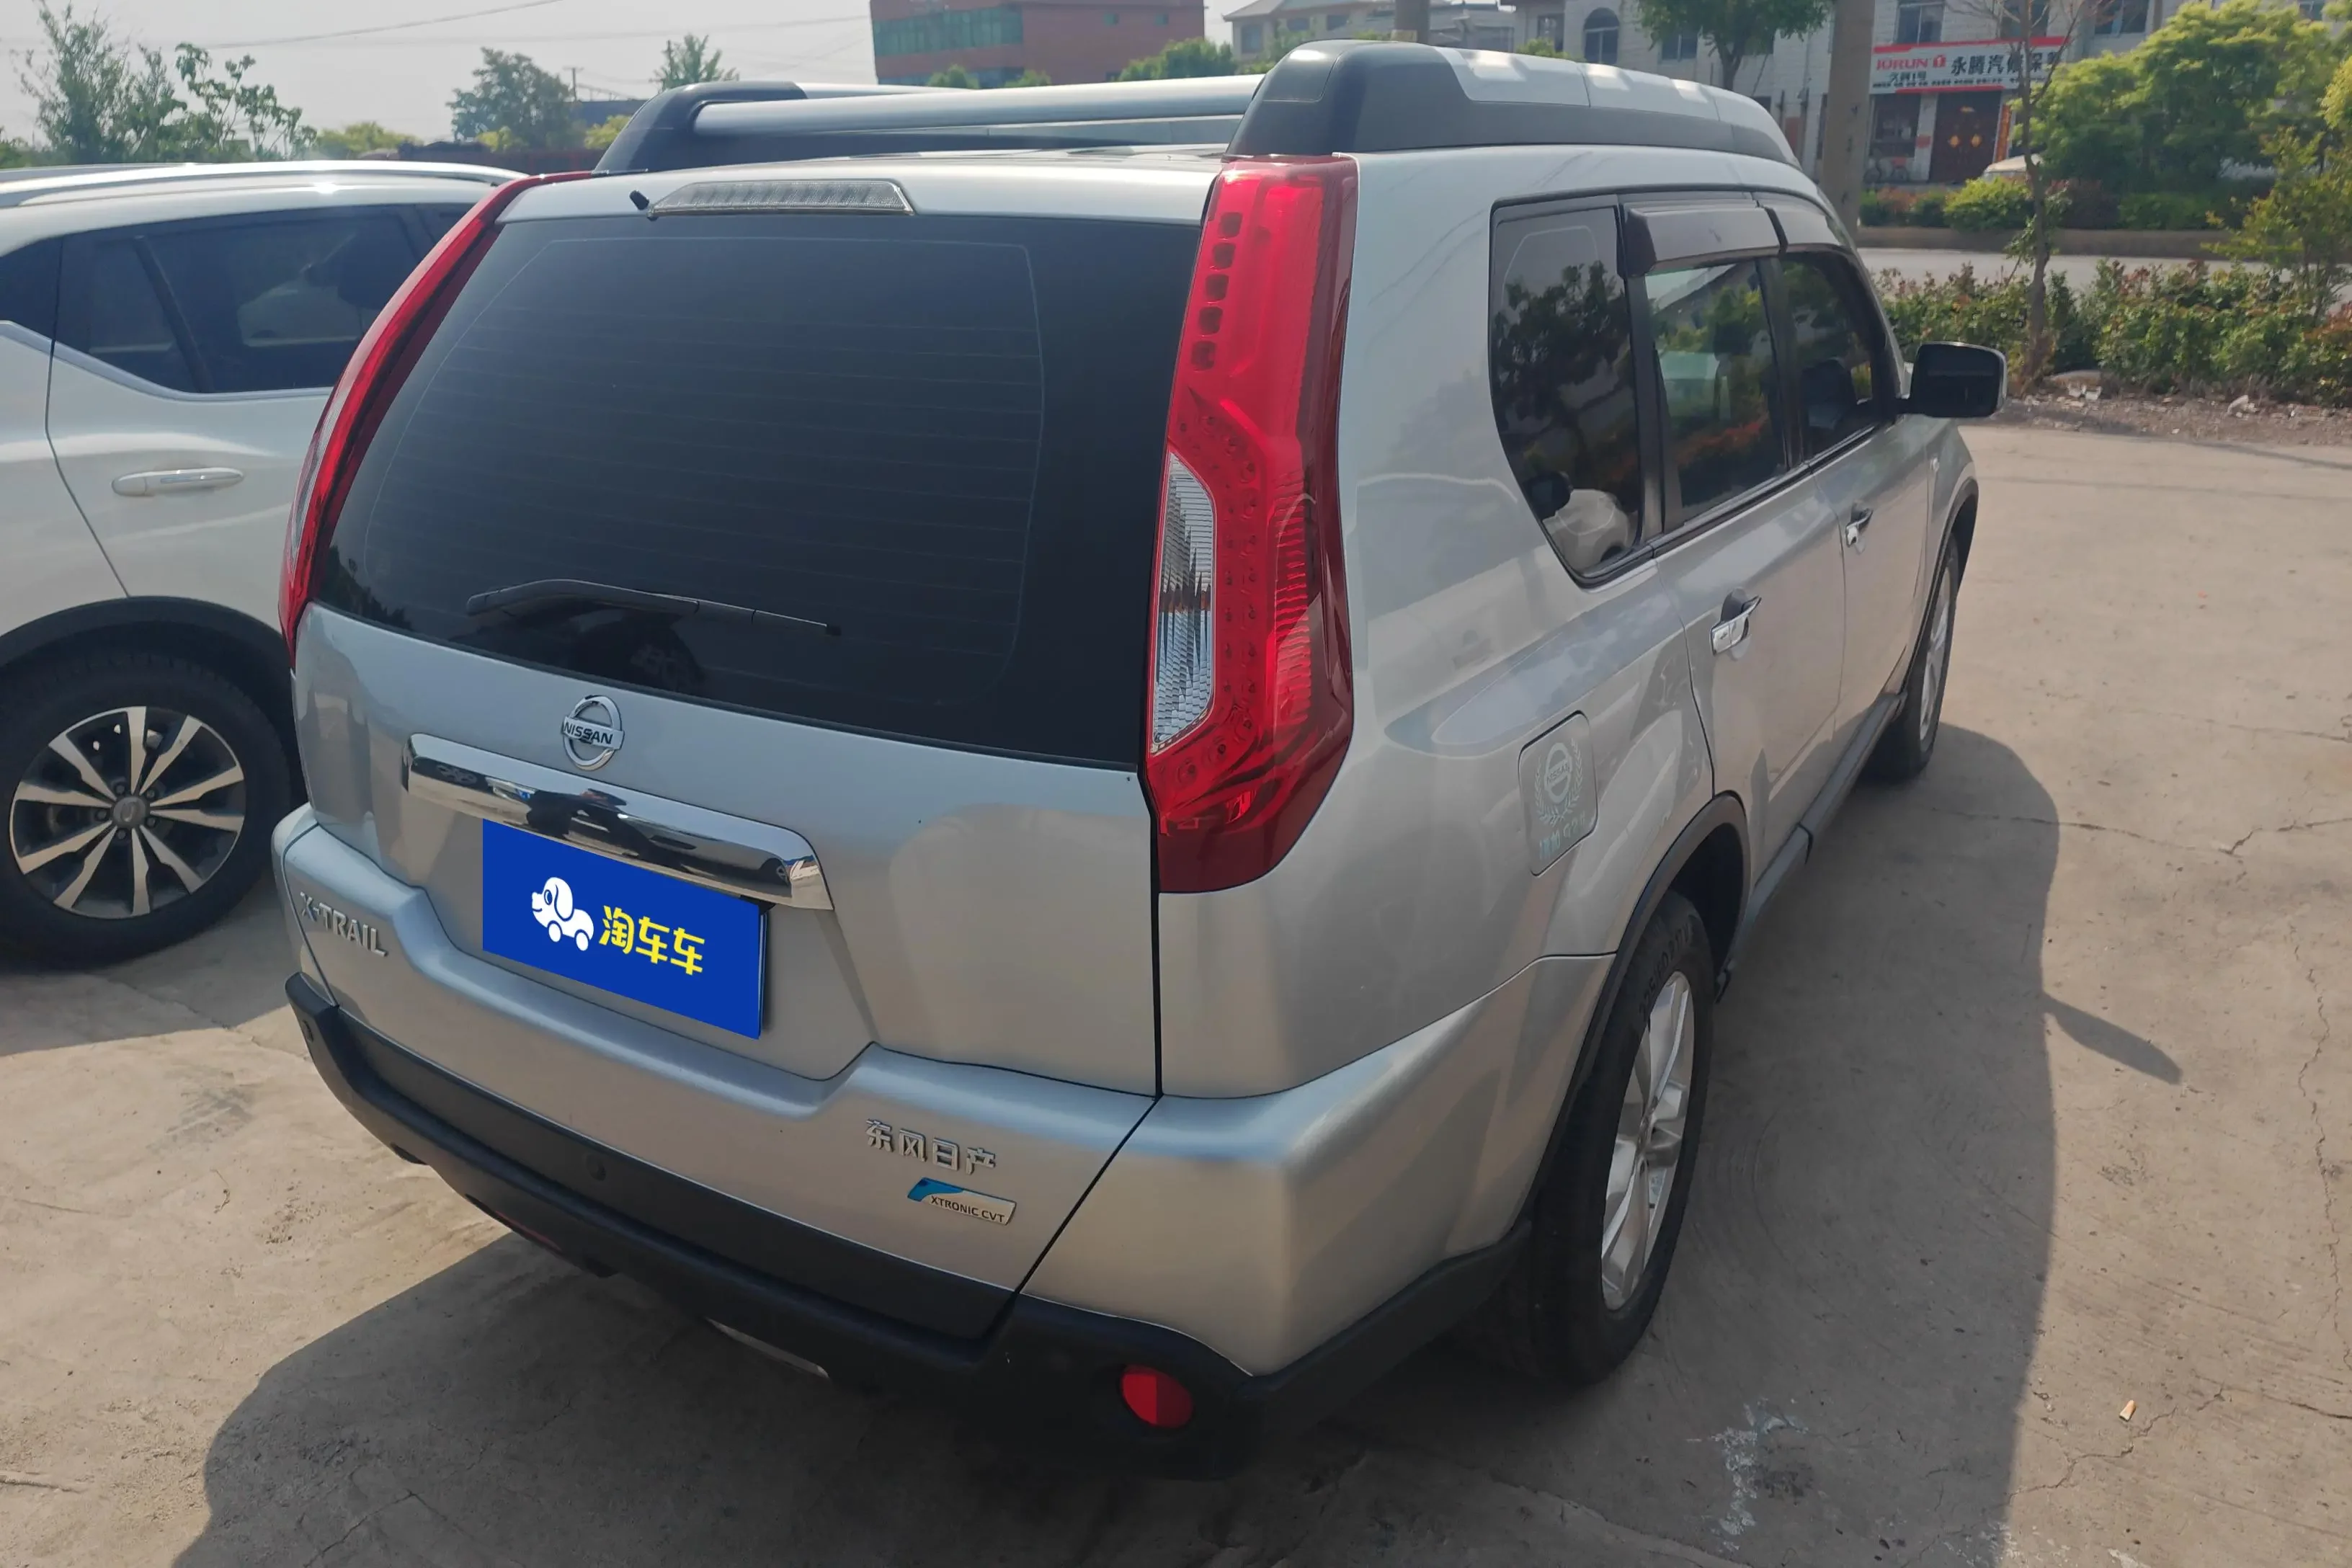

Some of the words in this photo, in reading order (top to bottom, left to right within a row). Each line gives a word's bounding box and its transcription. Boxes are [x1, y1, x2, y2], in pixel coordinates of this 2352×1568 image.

[564, 721, 613, 744] NISSAN
[300, 891, 388, 958] X-TRAIL
[865, 1118, 996, 1175] 东风日产
[931, 1195, 979, 1217] XTRONIC
[981, 1210, 1005, 1224] CVT
